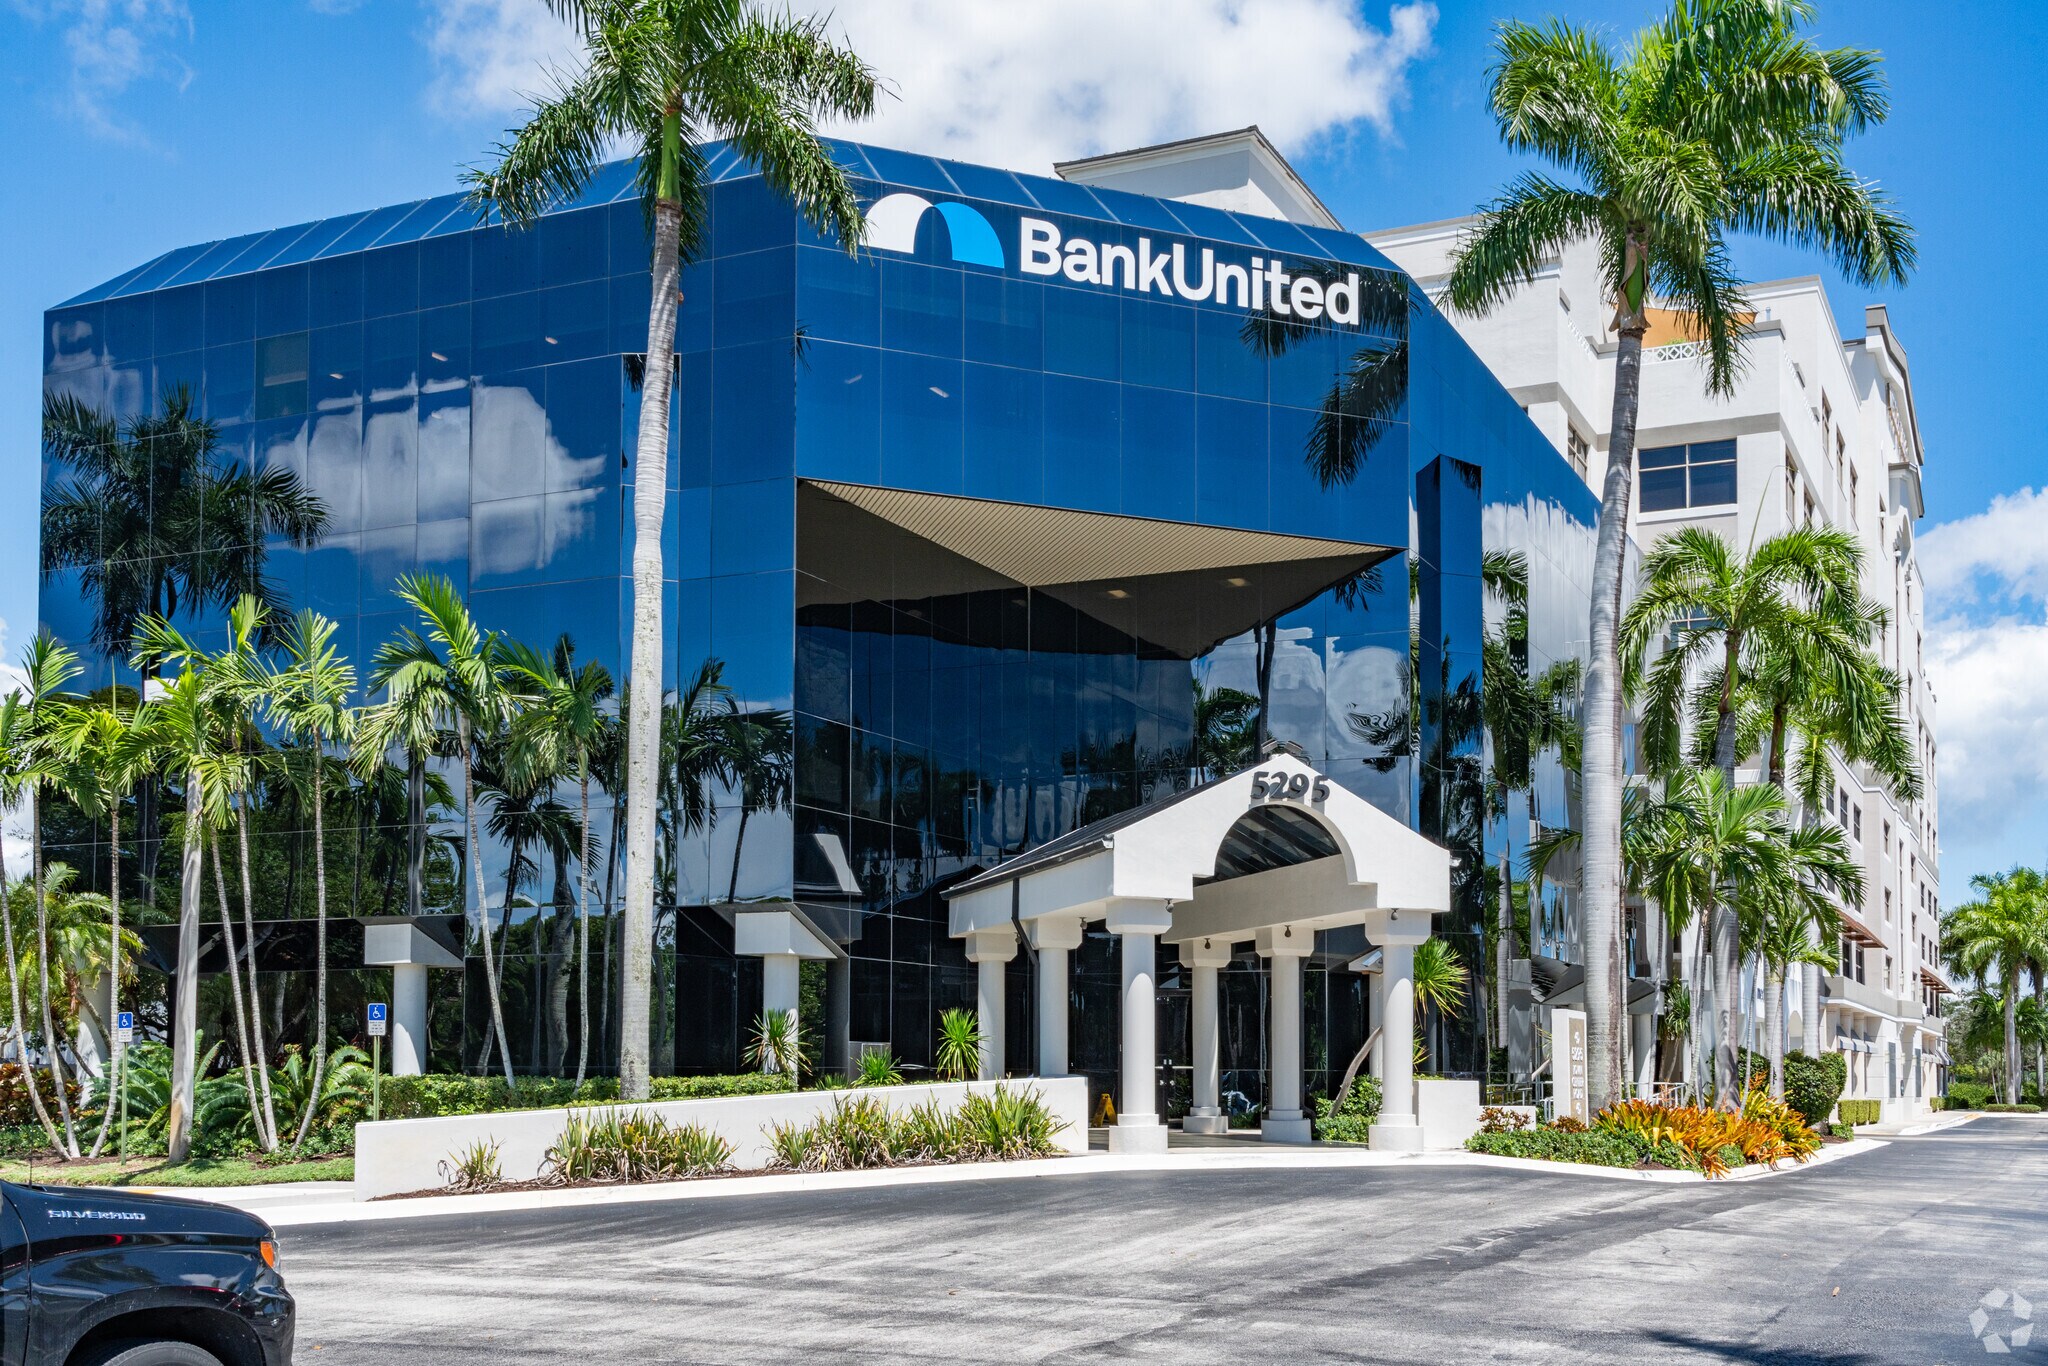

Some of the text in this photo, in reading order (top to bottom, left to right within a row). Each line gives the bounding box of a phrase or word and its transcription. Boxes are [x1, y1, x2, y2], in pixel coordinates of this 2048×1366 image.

[1020, 216, 1360, 326] BankUnited
[1250, 771, 1330, 802] 5295
[48, 1210, 146, 1220] SILVERADO
